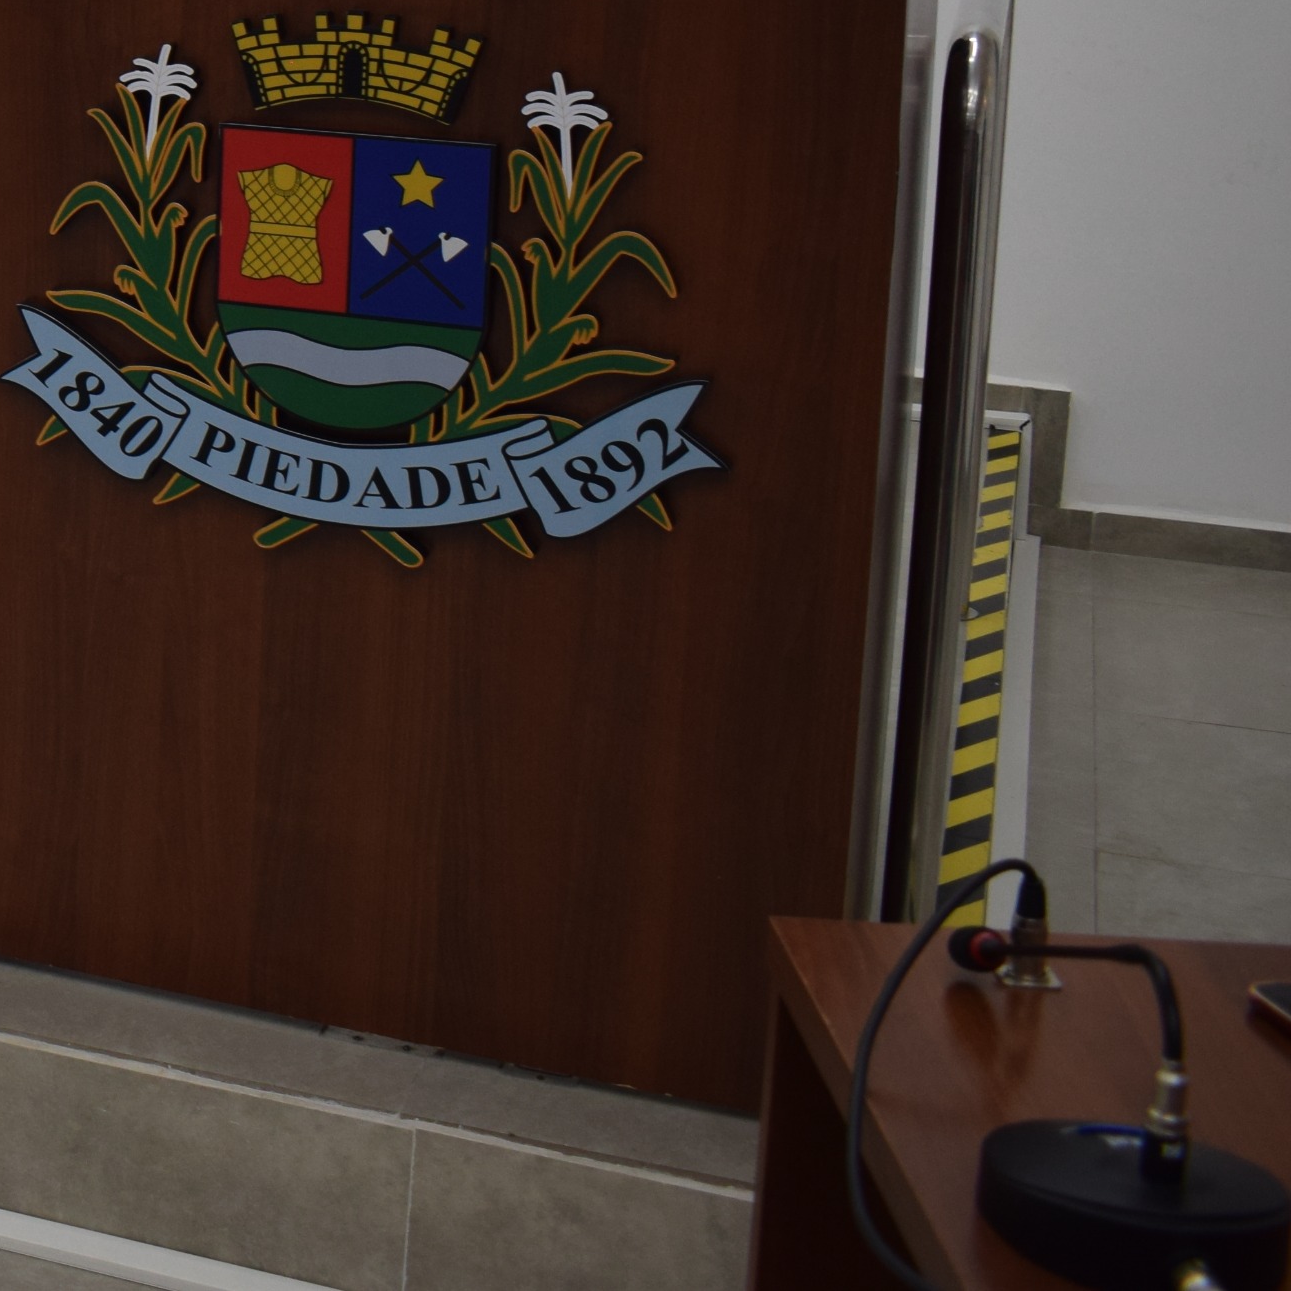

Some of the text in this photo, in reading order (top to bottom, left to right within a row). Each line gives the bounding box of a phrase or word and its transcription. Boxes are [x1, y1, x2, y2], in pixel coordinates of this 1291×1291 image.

[28, 348, 163, 457] 1840
[189, 421, 501, 509] PIEDADE
[529, 418, 690, 514] 1892
